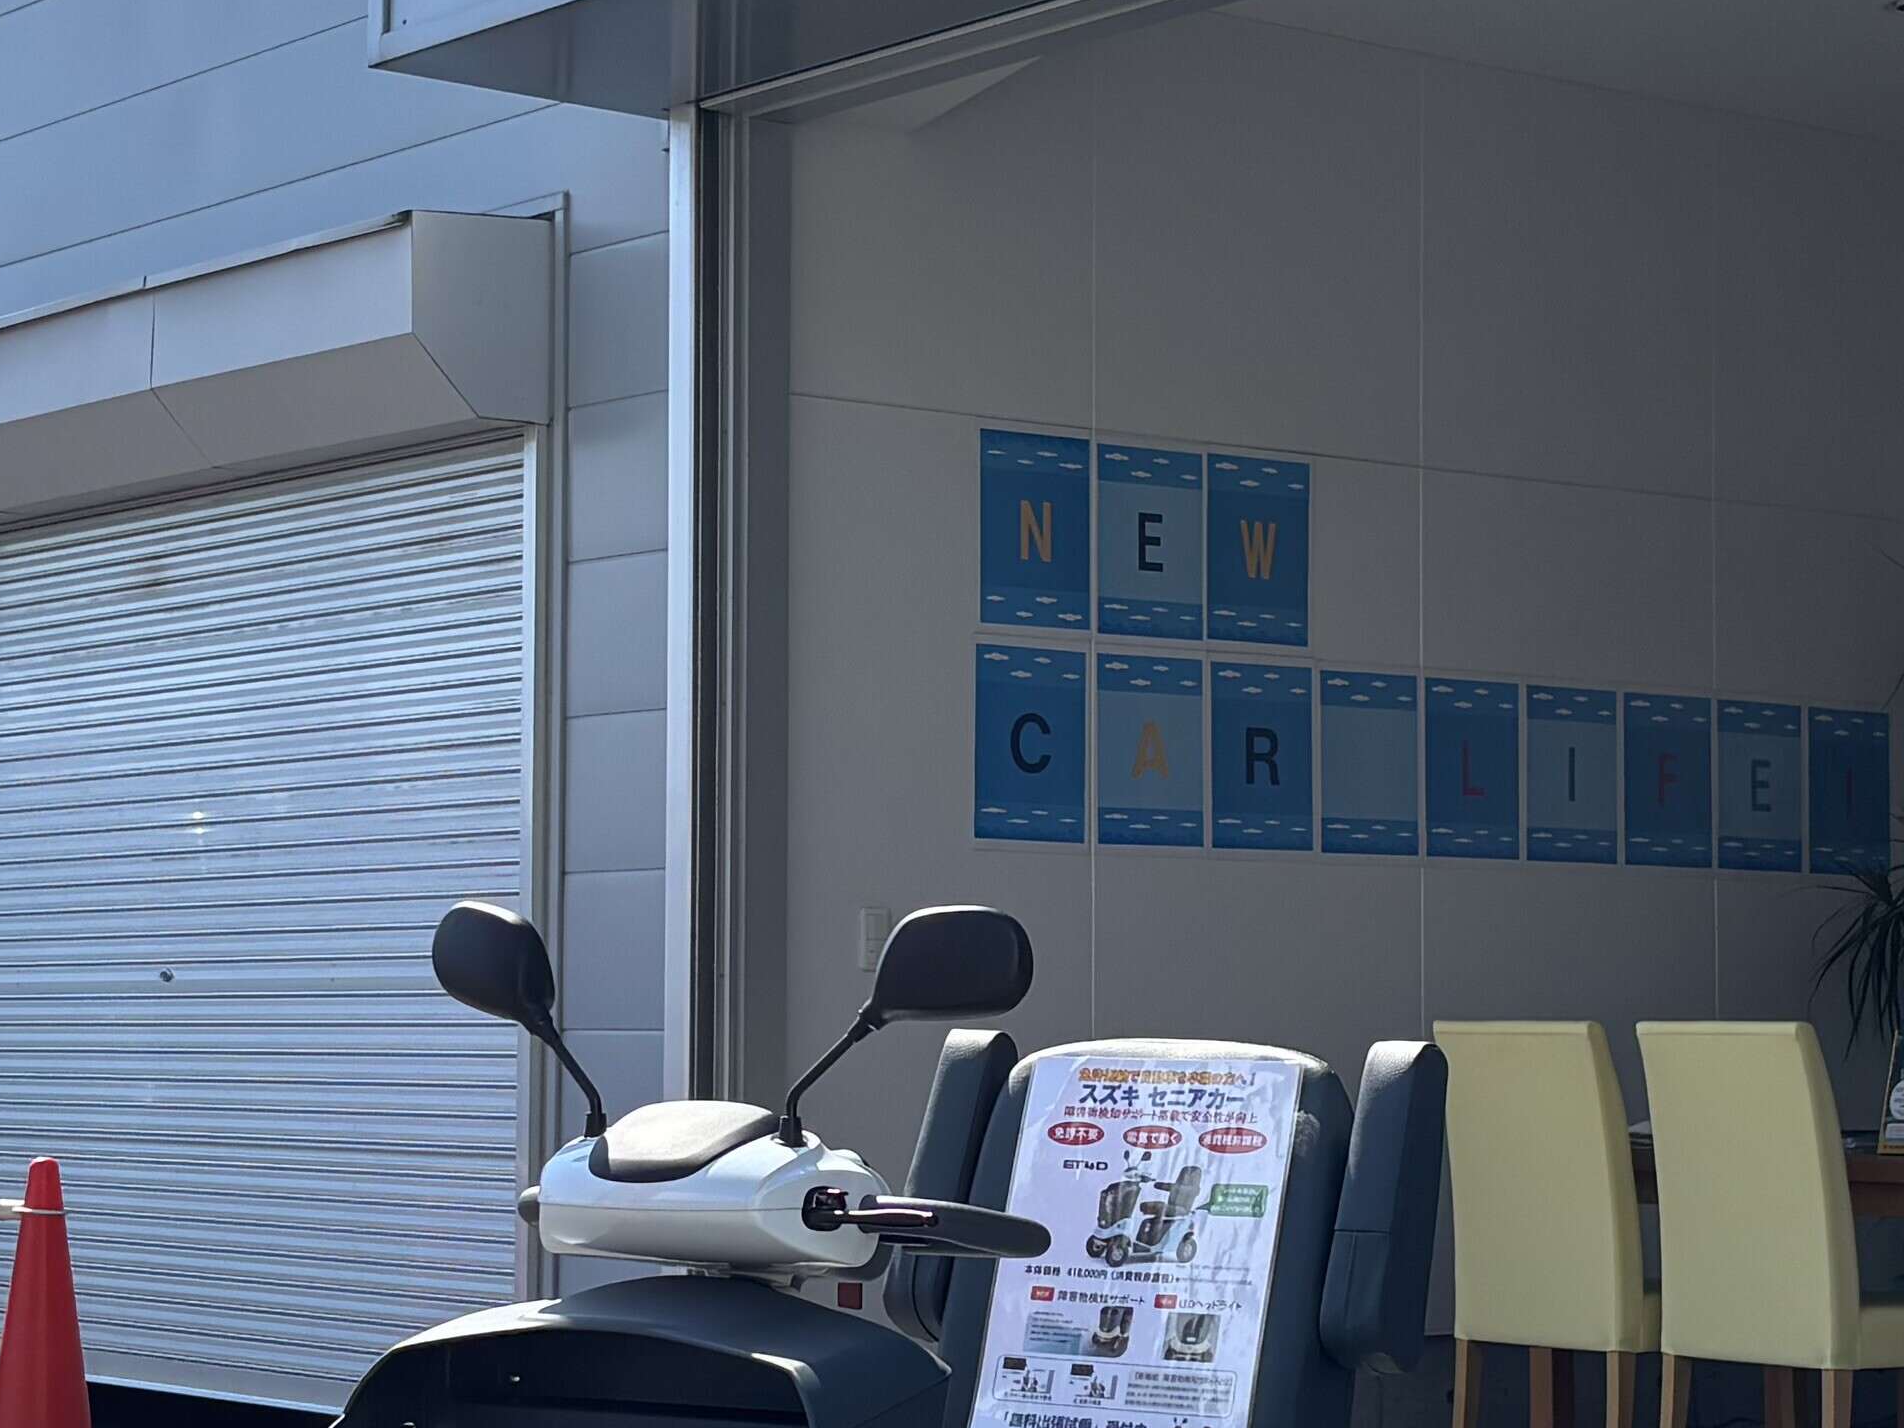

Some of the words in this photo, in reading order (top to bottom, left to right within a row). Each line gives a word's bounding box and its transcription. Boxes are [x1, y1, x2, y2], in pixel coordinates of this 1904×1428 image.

[1018, 498, 1277, 581] NEW
[1009, 711, 1281, 786] CAR
[1079, 1084, 1140, 1106] スズキ
[1148, 1086, 1245, 1110] セニアカー
